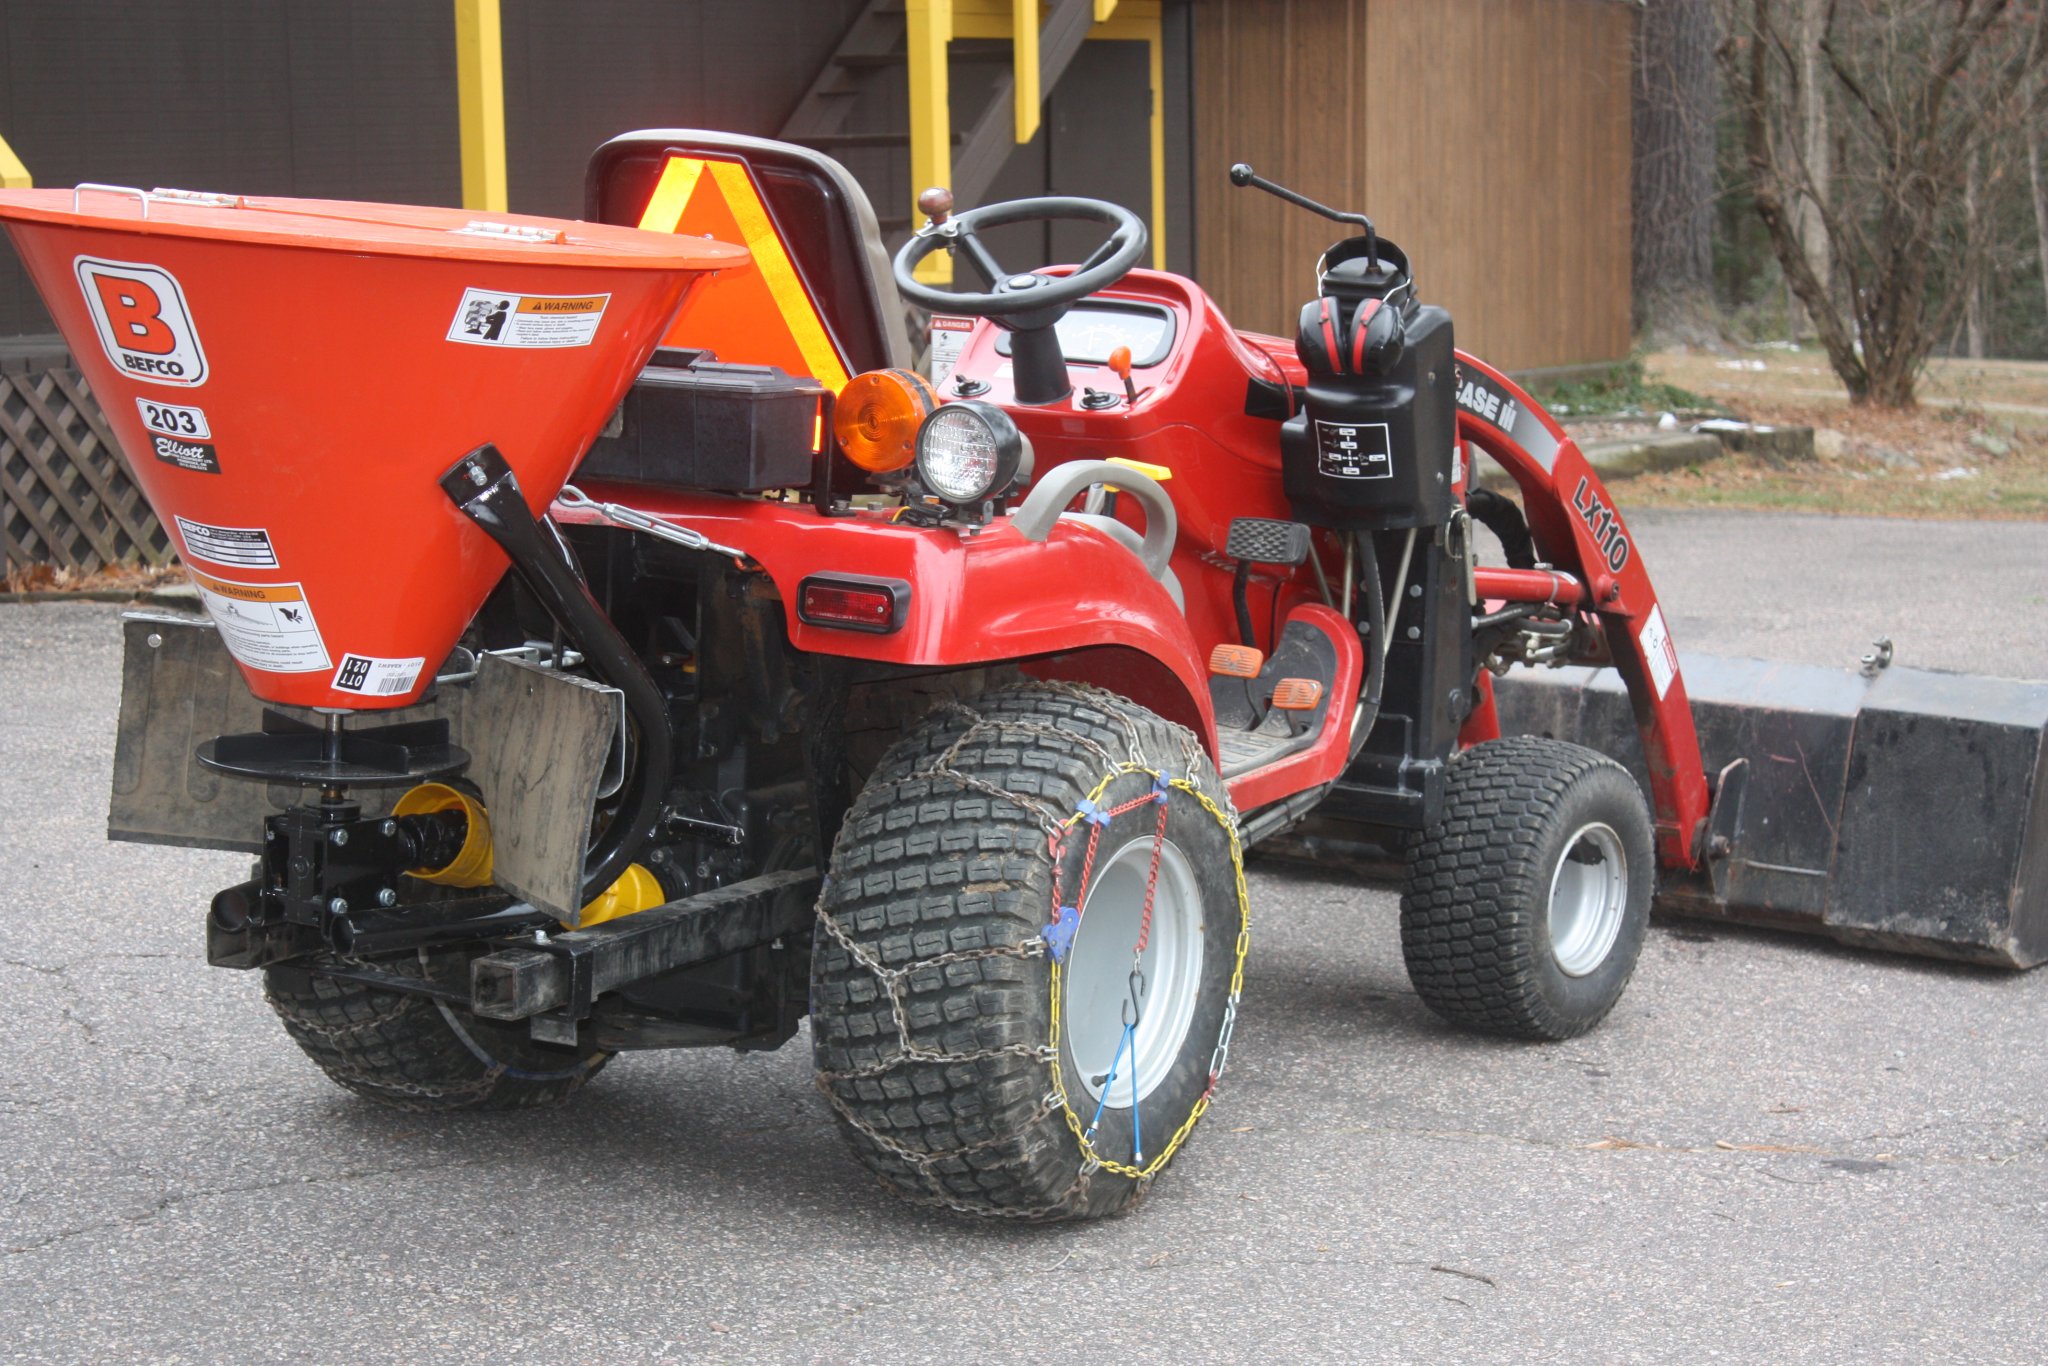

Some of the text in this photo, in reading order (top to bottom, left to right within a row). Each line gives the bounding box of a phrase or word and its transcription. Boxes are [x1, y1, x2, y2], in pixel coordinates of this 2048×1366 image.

[91, 271, 176, 356] B
[543, 301, 594, 311] WARNING
[942, 320, 970, 329] DANGER
[122, 353, 185, 376] BEFCO
[147, 405, 197, 434] 203
[156, 437, 205, 459] Elliott
[180, 520, 210, 536] BEFCO
[1572, 475, 1629, 573] LX110
[220, 584, 266, 599] WARNING
[346, 660, 369, 673] 021
[340, 673, 363, 687] OTT
